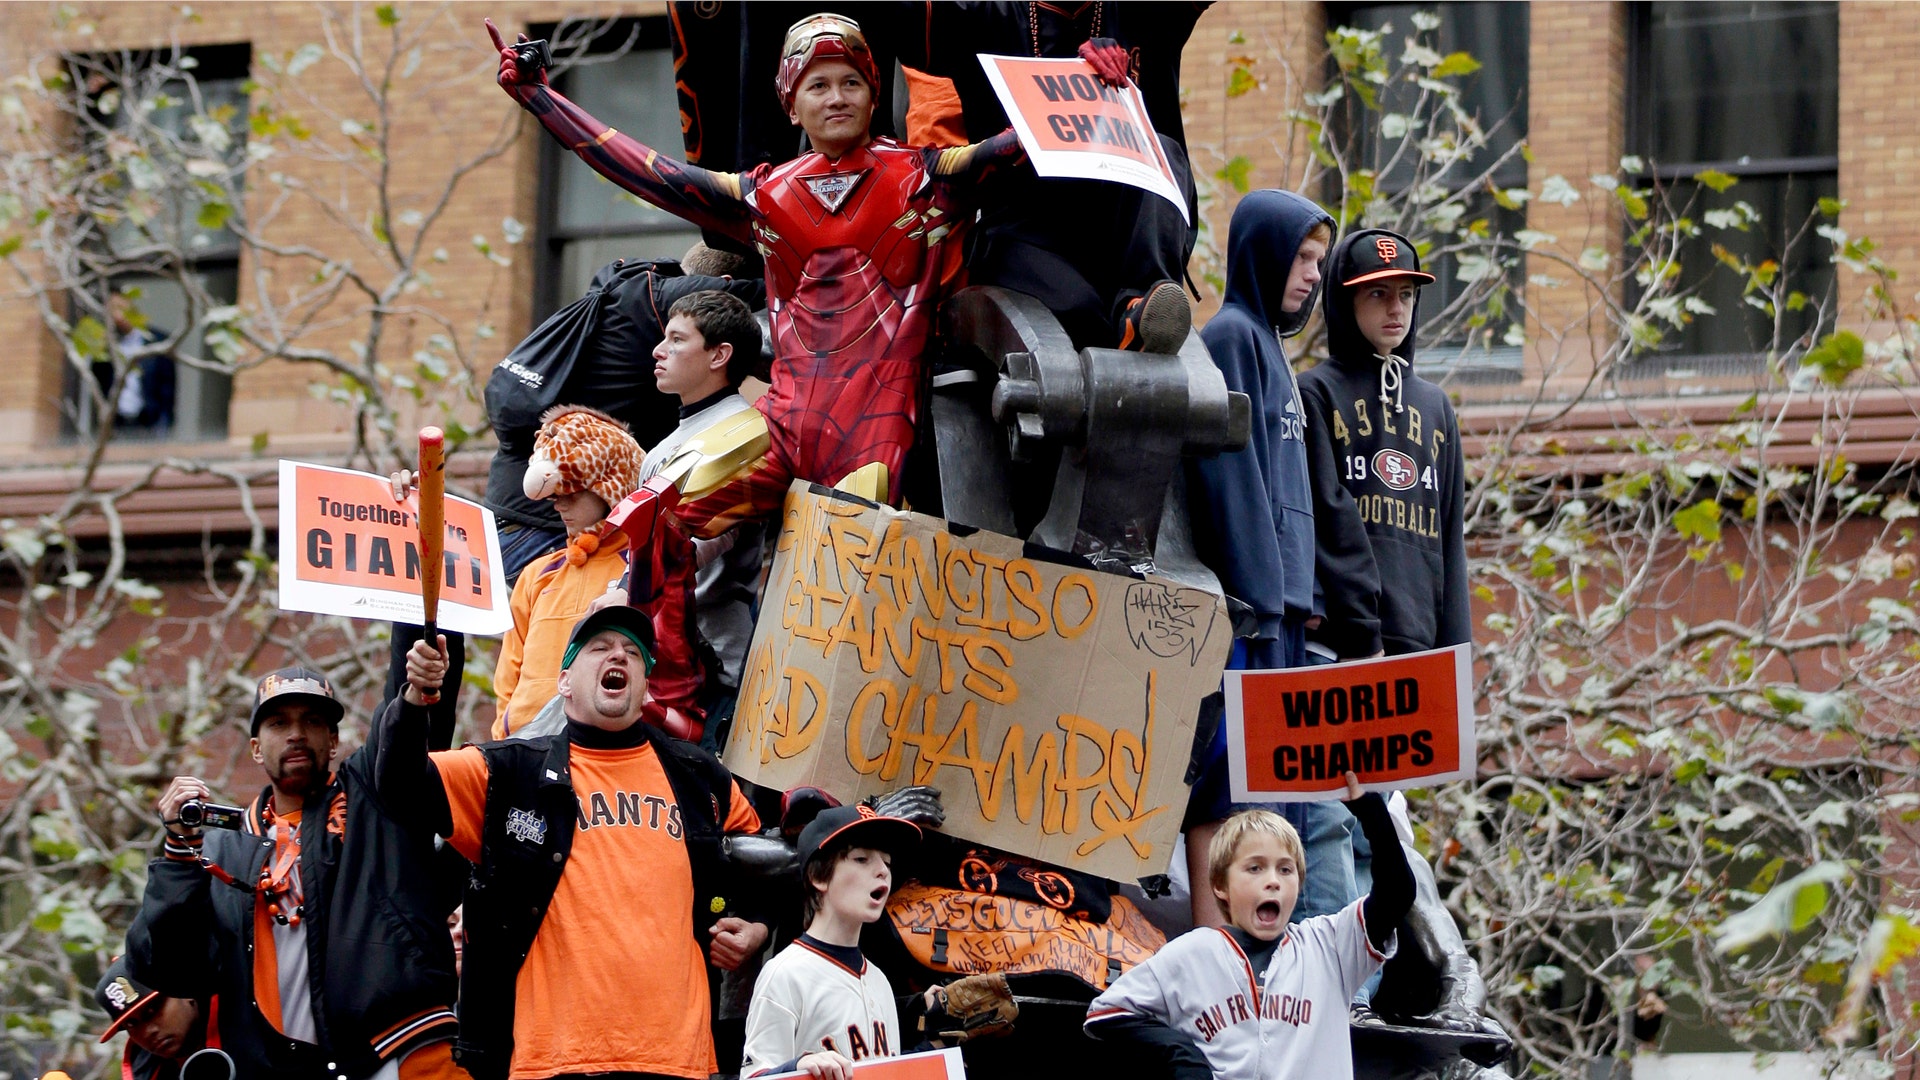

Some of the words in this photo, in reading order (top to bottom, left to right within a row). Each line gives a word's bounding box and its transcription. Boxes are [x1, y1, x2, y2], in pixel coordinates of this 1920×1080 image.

[1334, 398, 1445, 463] 49ERS
[1345, 455, 1367, 480] 19
[318, 496, 410, 528] Together
[1353, 494, 1439, 538] OOTBALL
[782, 571, 1019, 705] GIANTS
[1281, 677, 1419, 729] WORLD
[1273, 729, 1434, 782] CHAMPS
[507, 820, 544, 844] DELIVERY
[511, 810, 542, 829] AERO
[959, 936, 1017, 963] KEEP
[995, 961, 1023, 972] 2012
[1194, 1010, 1228, 1043] SAN
